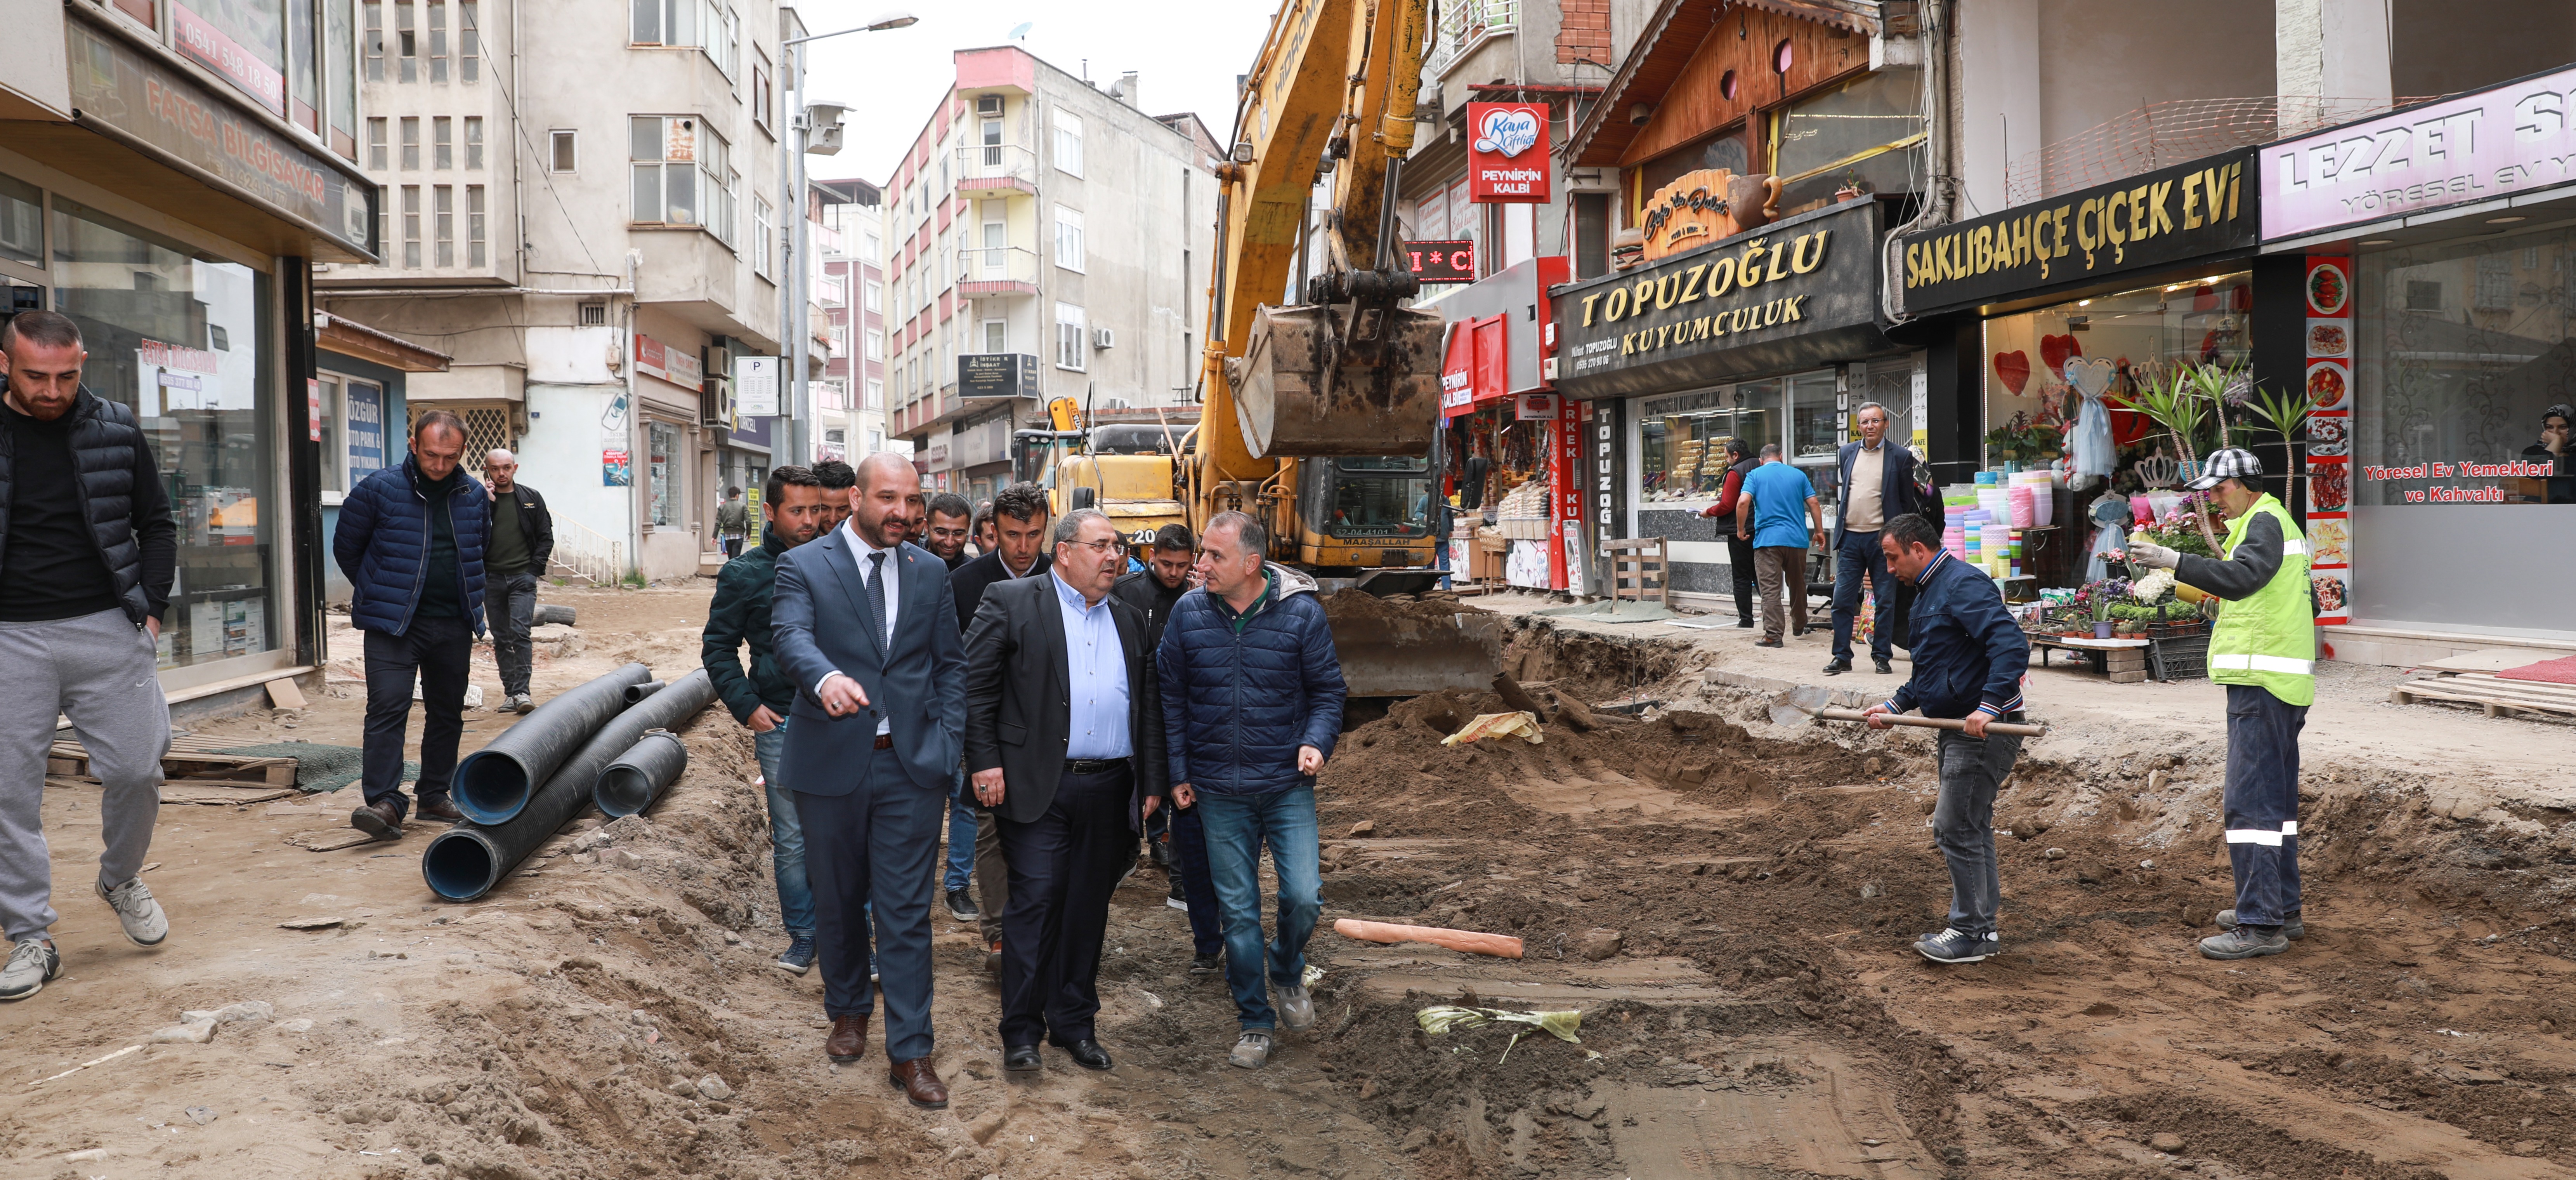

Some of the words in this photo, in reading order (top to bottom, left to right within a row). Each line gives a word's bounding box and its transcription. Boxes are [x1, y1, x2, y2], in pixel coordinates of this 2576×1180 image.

[186, 23, 218, 61] 0541
[222, 46, 244, 77] 548
[247, 65, 261, 89] 18
[264, 75, 277, 99] 50
[1490, 116, 1530, 141] Kaya
[147, 80, 218, 147] FATSA
[224, 122, 325, 205] BİLGİSAYAR
[1503, 133, 1536, 149] Çiftliği
[2279, 107, 2484, 196] LEZZET
[2515, 88, 2576, 144] S
[238, 171, 260, 194] 424
[1481, 167, 1541, 181] PEYNİR'İN
[1494, 181, 1530, 194] KALBİ
[2341, 174, 2484, 215] YÖRESEL
[2493, 160, 2541, 186] EV
[1644, 202, 1670, 240] Cafe
[1907, 204, 2071, 289] SAKLIBAHÇE
[2076, 179, 2174, 270] ÇİÇEK
[2182, 160, 2242, 231] EVİ
[1581, 230, 1830, 328] TOPUZOĞLU
[1620, 294, 1807, 356] KUYUMCULUK
[142, 338, 169, 367] FATSA
[171, 343, 218, 376] BİLGİSAYAR
[1572, 345, 1584, 358] Nihat
[1585, 336, 1618, 355] TOPUZOĞLU
[753, 361, 760, 371] P
[1577, 359, 1587, 370] 0535
[1588, 357, 1596, 368] 270
[1596, 356, 1602, 366] 98
[1603, 355, 1609, 365] 06
[1442, 368, 1468, 391] PEYNİRİN
[349, 394, 378, 424] ÖZGÜR
[1444, 388, 1459, 408] KALBİ
[1644, 396, 1678, 416] TOPUZOĞLU
[1679, 391, 1721, 412] KUYUMCULUK
[738, 416, 756, 433] TURKCELL
[349, 429, 359, 447] OTO
[360, 431, 375, 448] PARK
[350, 455, 360, 469] OTO
[2364, 462, 2428, 481] Yöresel
[2432, 462, 2455, 478] Ev
[2458, 460, 2553, 477] Yemekleri
[2404, 490, 2425, 502] ve
[2429, 485, 2504, 502] Kahvaltı
[1134, 529, 1158, 543] 20
